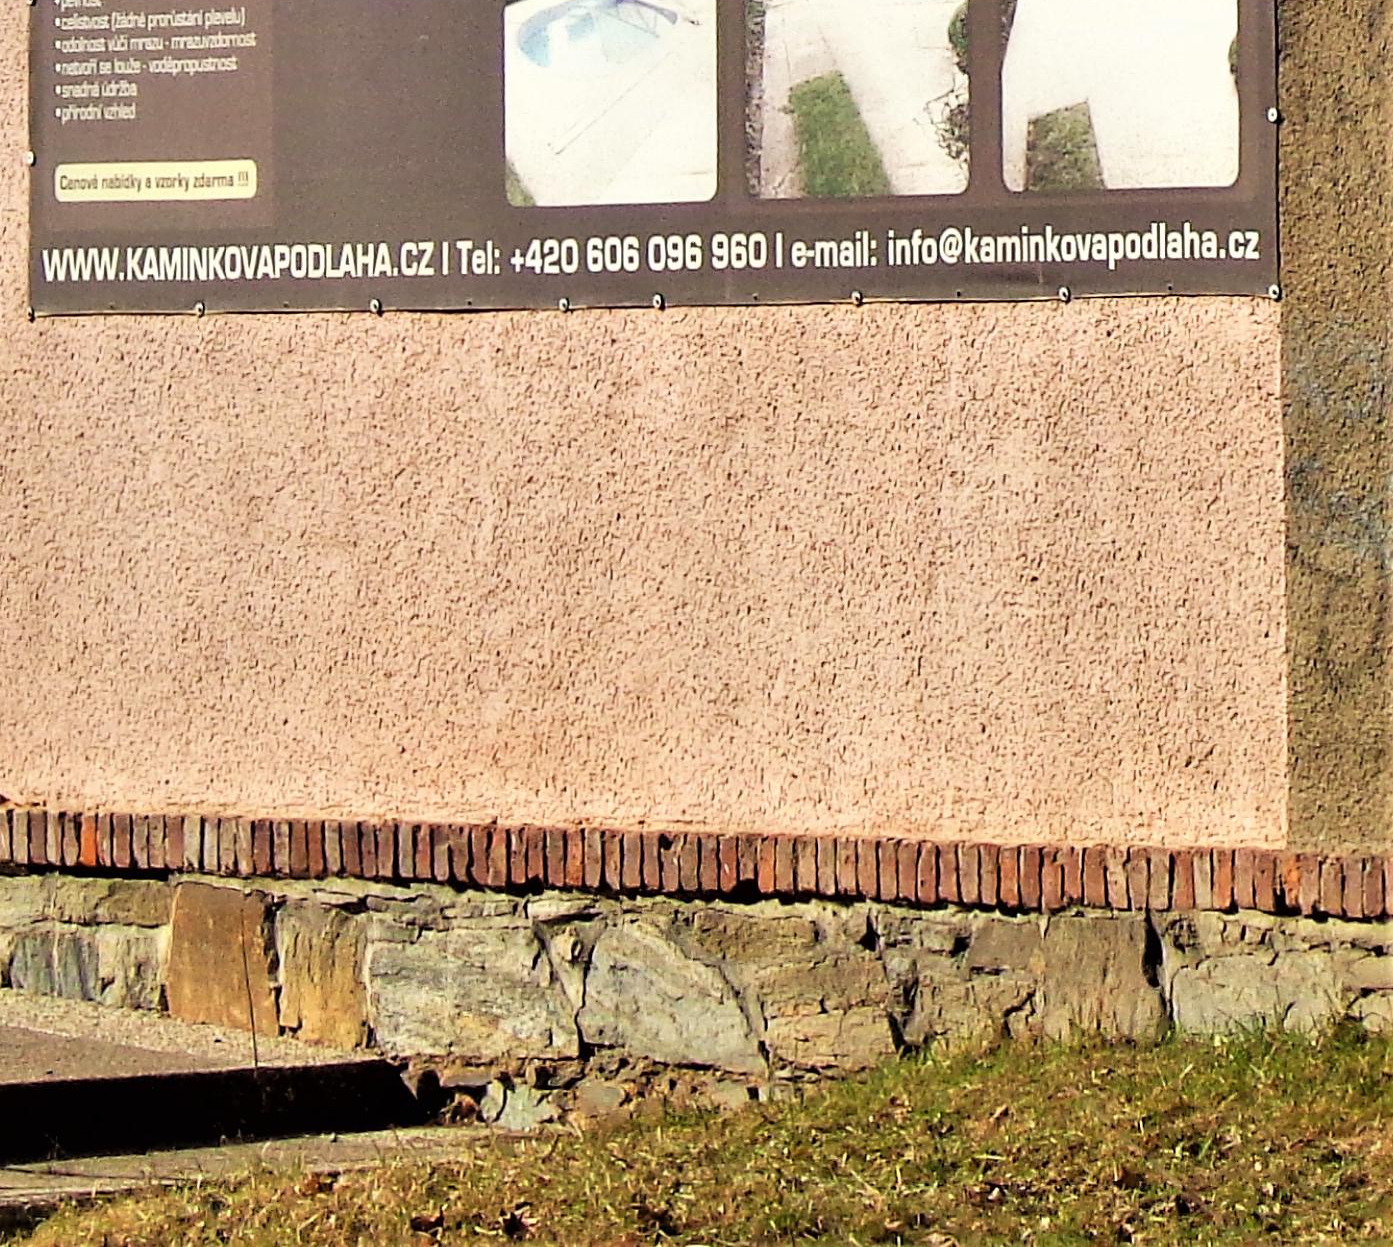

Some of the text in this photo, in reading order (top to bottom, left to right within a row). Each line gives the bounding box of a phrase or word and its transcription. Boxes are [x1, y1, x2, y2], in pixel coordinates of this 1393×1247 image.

[59, 174, 99, 191] Cenové
[101, 172, 143, 192] nabídky
[145, 177, 152, 189] a
[154, 171, 191, 192] vzorky
[192, 171, 235, 189] zdarma
[42, 241, 435, 282] WWW.KAMINKOVAPODLAHA.CZ
[456, 239, 501, 275] Tel:
[510, 238, 580, 275] +420
[585, 235, 640, 272] 606
[646, 234, 703, 271] 096
[711, 232, 767, 270] 960
[790, 230, 877, 268] e-mail:
[887, 220, 1260, 270] info@kaminkovapodlaha.cz
